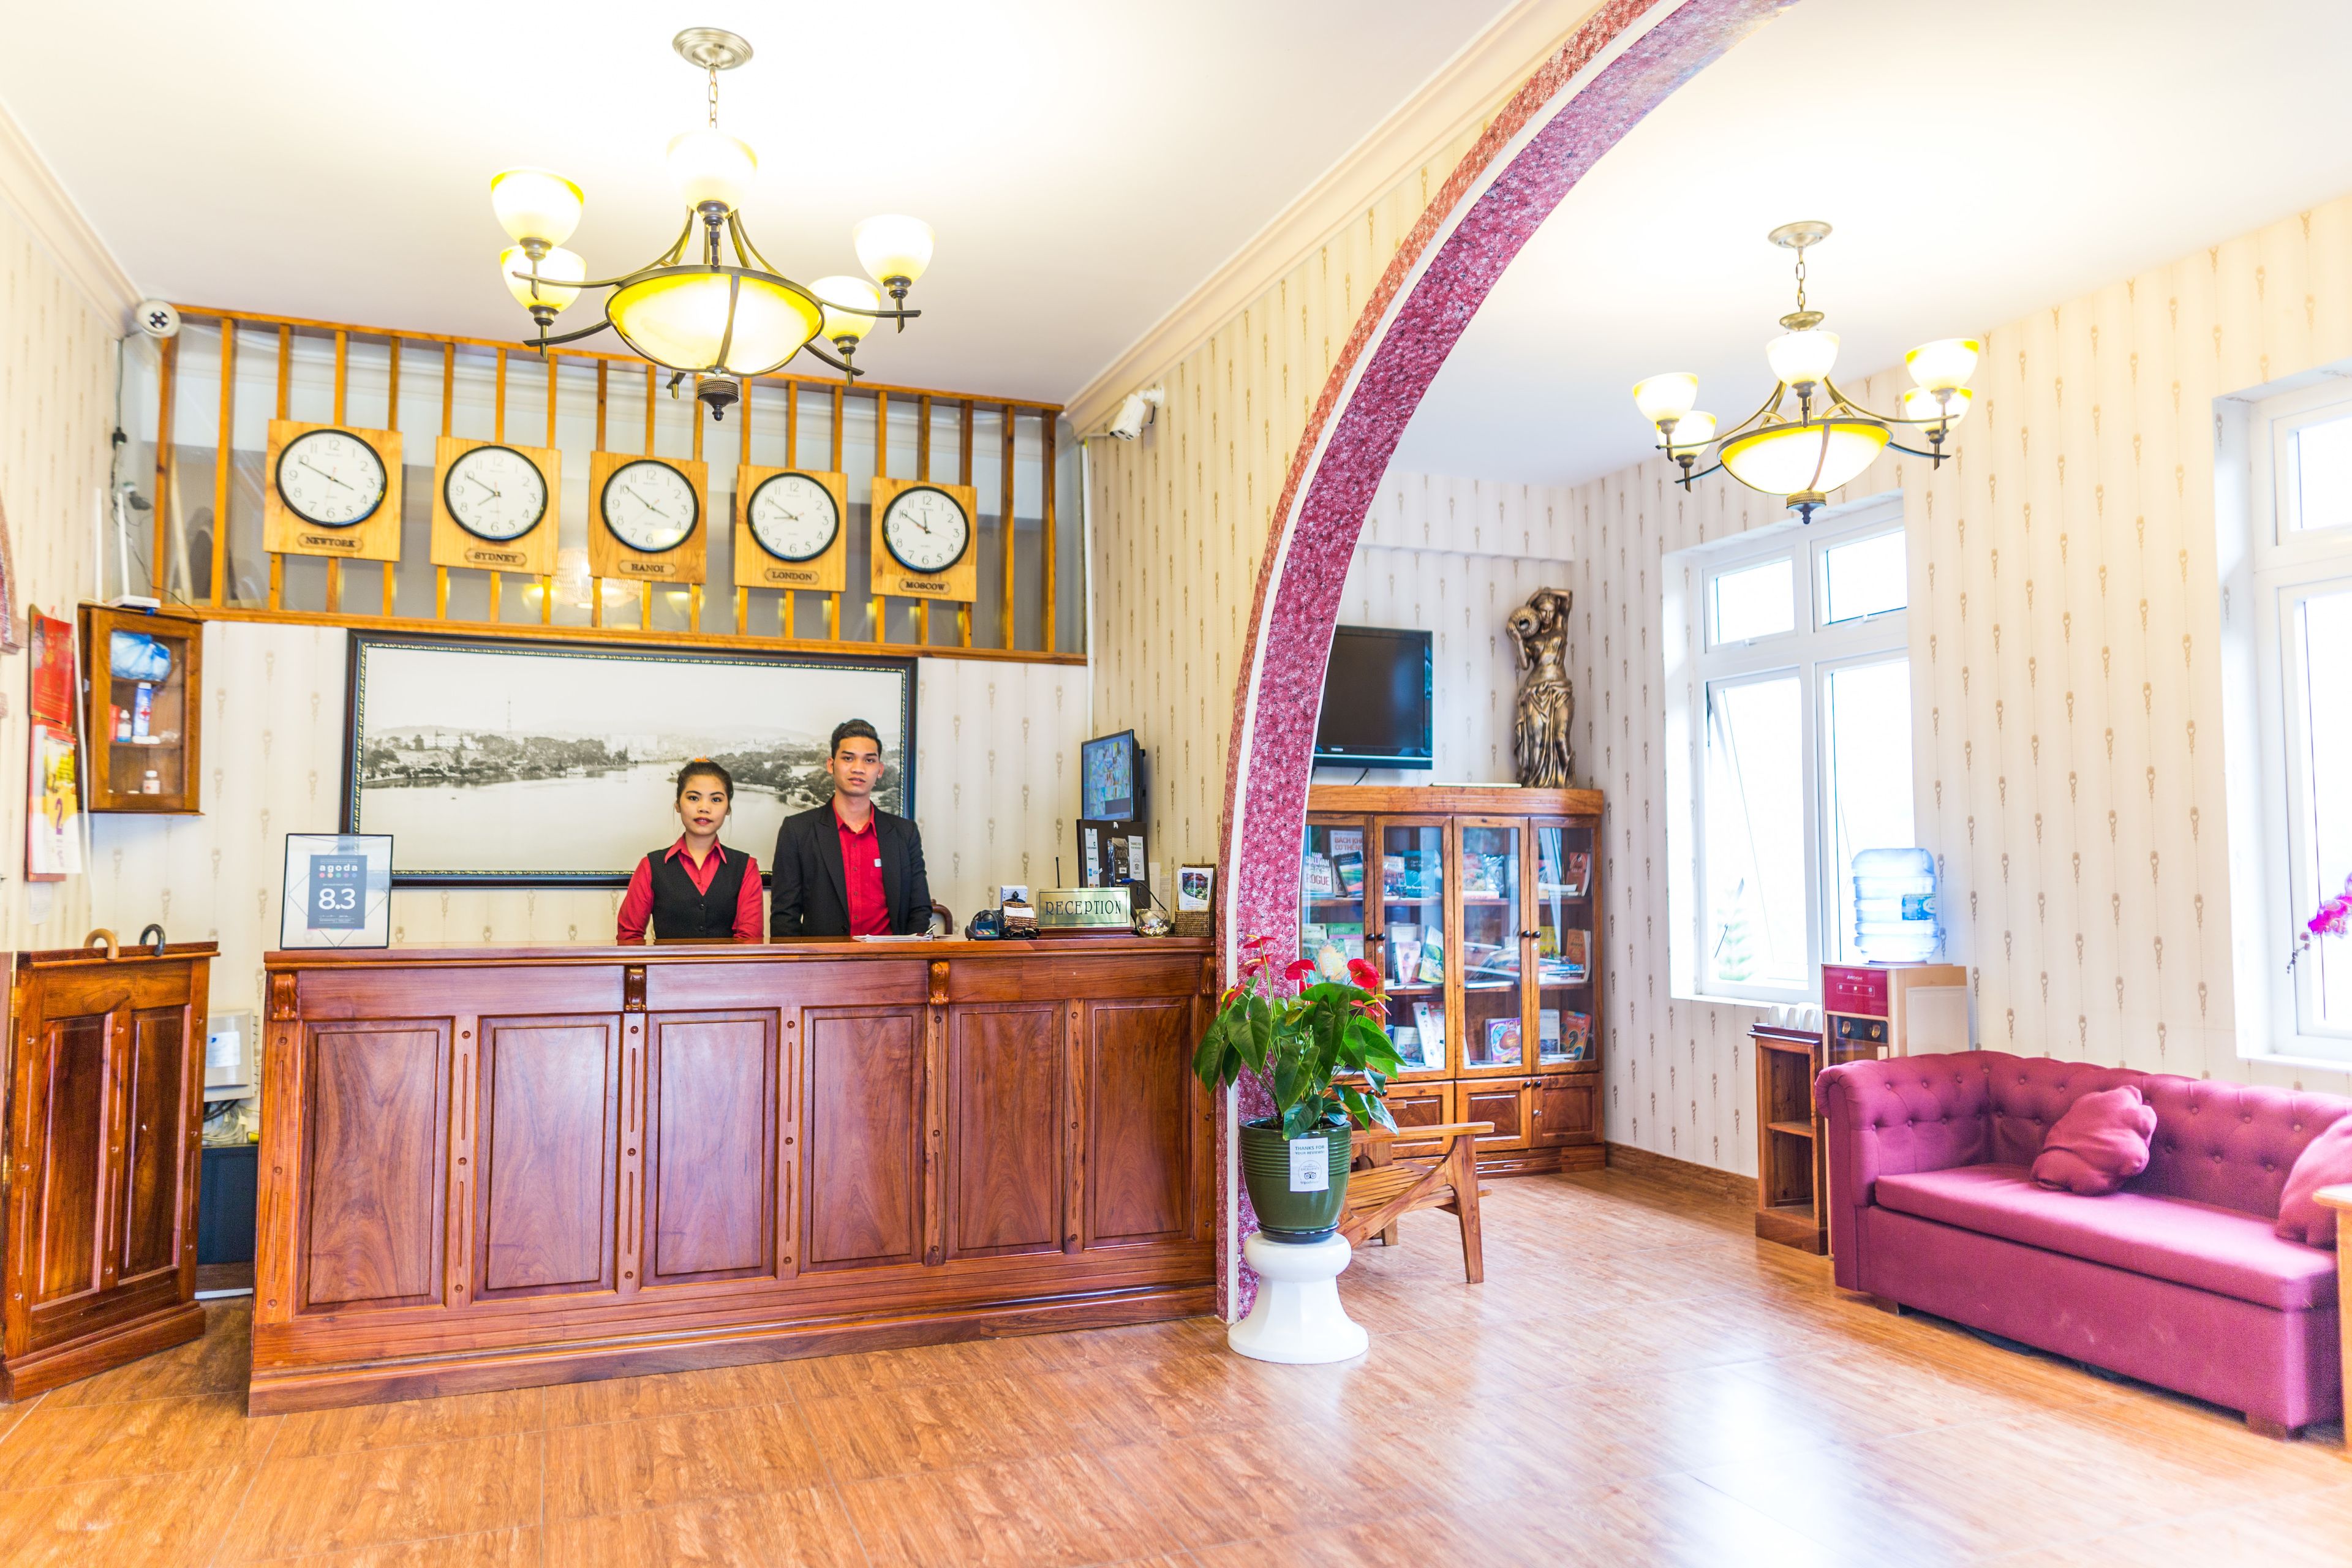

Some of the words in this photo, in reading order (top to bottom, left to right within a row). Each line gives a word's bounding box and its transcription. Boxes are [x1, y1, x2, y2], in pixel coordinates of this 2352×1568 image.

[311, 443, 317, 453] 11
[329, 440, 340, 451] 12
[353, 448, 355, 458] 1
[298, 454, 309, 464] 10
[493, 456, 504, 467] 12
[360, 461, 368, 471] 2
[476, 459, 482, 470] 11
[515, 464, 518, 473] 1
[289, 470, 298, 481] 9
[464, 470, 475, 480] 10
[631, 473, 636, 483] 11
[646, 470, 657, 480] 12
[368, 478, 375, 488] 3
[522, 477, 530, 487] 2
[667, 477, 669, 486] 1
[456, 486, 464, 496] 9
[620, 484, 630, 494] 10
[775, 486, 780, 495] 11
[790, 482, 799, 492] 12
[293, 488, 301, 498] 8
[529, 493, 536, 503] 3
[674, 489, 681, 499] 2
[809, 489, 812, 498] 1
[360, 495, 368, 503] 4
[612, 499, 620, 509] 9
[765, 497, 774, 507] 10
[908, 499, 914, 508] 11
[923, 496, 932, 505] 12
[309, 502, 317, 512] 7
[460, 502, 468, 513] 8
[680, 505, 688, 515] 3
[815, 500, 823, 510] 2
[941, 502, 944, 511] 1
[326, 507, 335, 518] 6
[345, 506, 353, 516] 5
[522, 509, 529, 519] 4
[758, 510, 765, 520] 9
[899, 510, 908, 519] 10
[475, 516, 482, 526] 7
[617, 515, 624, 525] 8
[822, 516, 829, 526] 3
[947, 514, 954, 523] 2
[491, 522, 499, 532] 6
[508, 520, 515, 530] 5
[675, 521, 681, 529] 4
[892, 523, 899, 533] 9
[630, 528, 637, 538] 7
[762, 526, 769, 535] 8
[816, 531, 823, 540] 4
[953, 529, 960, 538] 3
[305, 537, 355, 548] NEWYORK
[646, 533, 654, 543] 6
[774, 538, 782, 548] 7
[896, 538, 903, 548] 8
[790, 543, 797, 553] 6
[805, 541, 812, 551] 5
[948, 543, 954, 552] 4
[475, 552, 518, 562] SYDNEY
[908, 550, 914, 559] 7
[922, 555, 929, 564] 6
[937, 553, 943, 562] 5
[631, 564, 665, 573] HANOI
[772, 571, 812, 581] LONDON
[906, 581, 945, 590] MOSCOW
[1305, 856, 1329, 867] SULLIVAN
[319, 864, 358, 873] agoda
[1306, 873, 1330, 886] ROGUE
[318, 888, 355, 910] 8.3
[1046, 900, 1121, 915] RECEPTION
